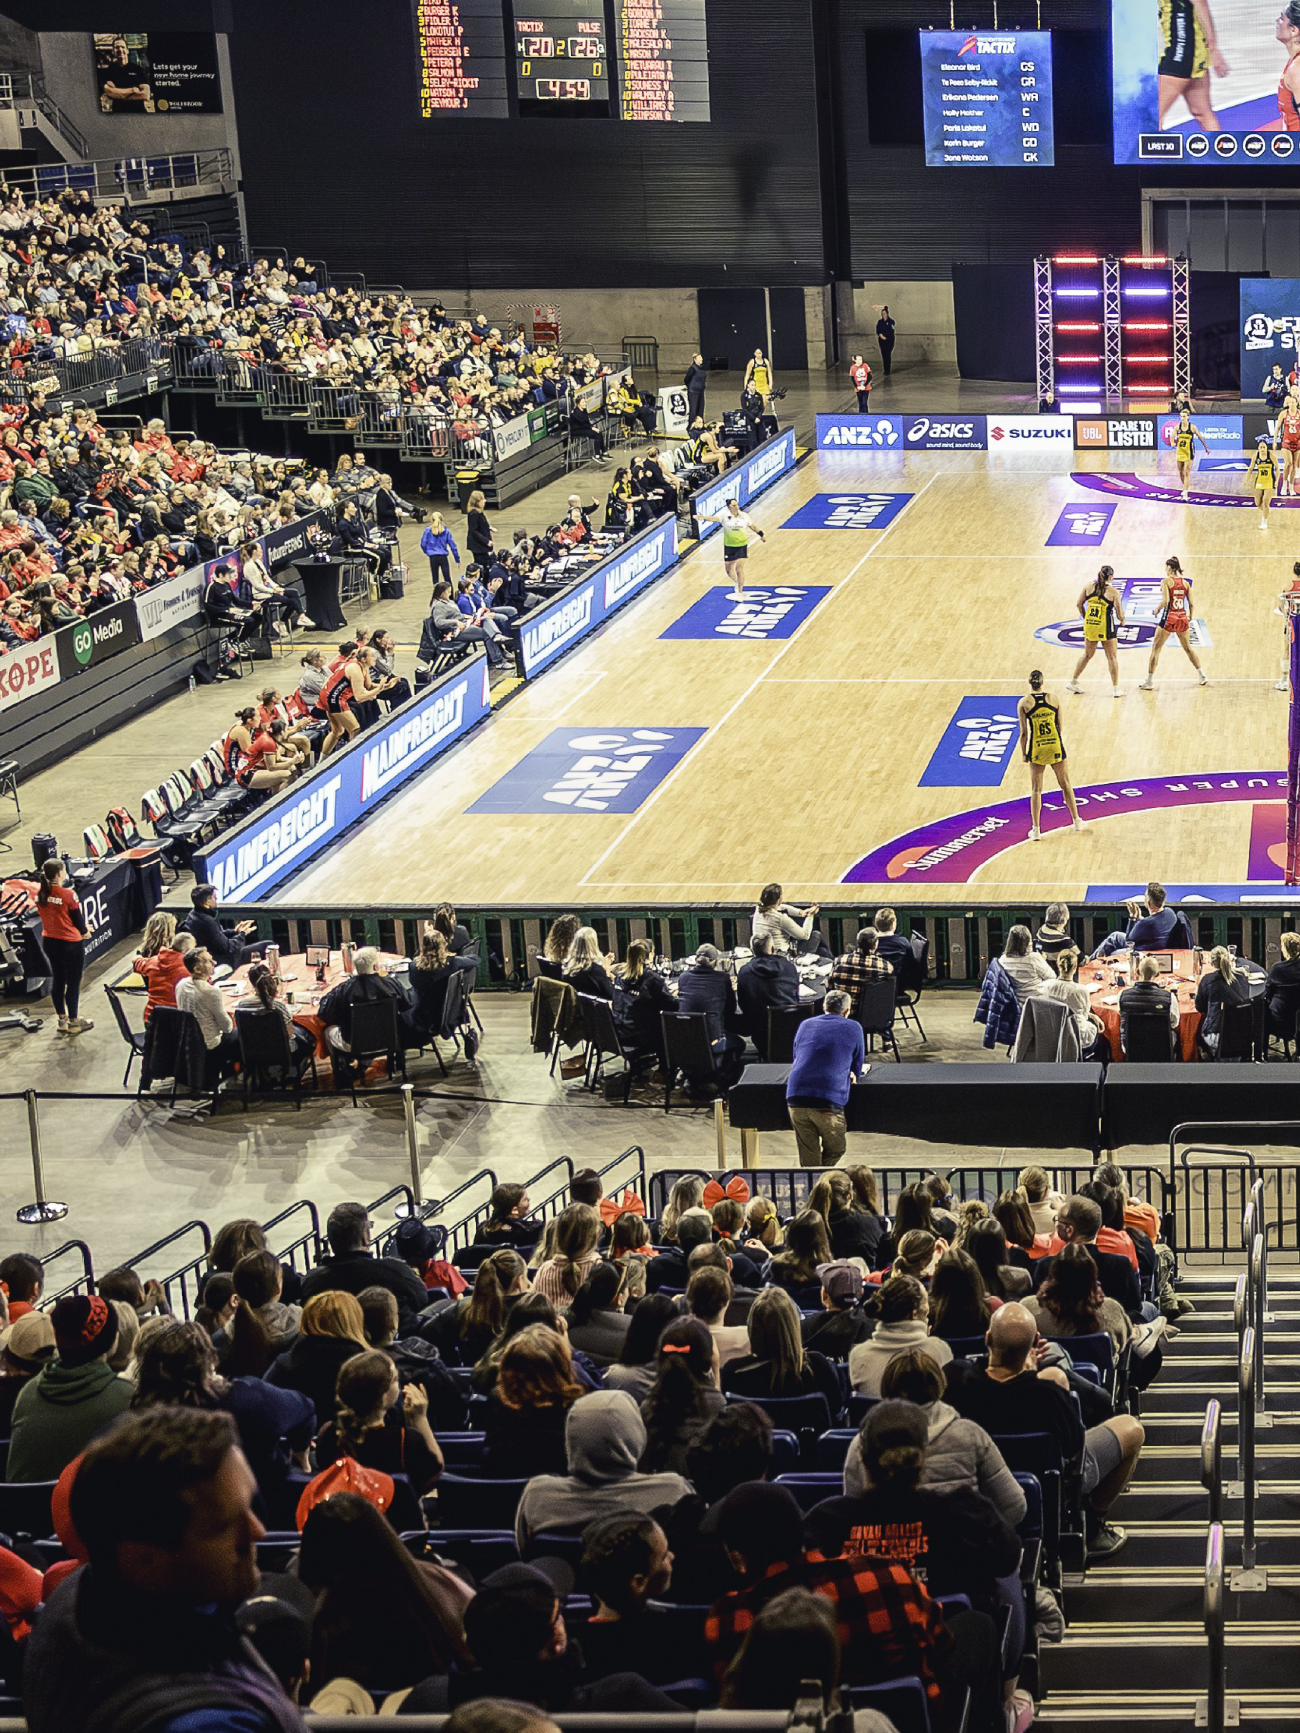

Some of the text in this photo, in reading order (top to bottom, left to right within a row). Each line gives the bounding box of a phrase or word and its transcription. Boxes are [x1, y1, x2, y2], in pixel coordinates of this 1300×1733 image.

[517, 21, 601, 32] TACTIX PULSE
[529, 38, 552, 56] 20
[556, 40, 566, 54] 2
[574, 39, 597, 56] 26
[977, 42, 1016, 54] TACTIX
[522, 62, 602, 76] 0 0
[1020, 62, 1034, 72] GS
[1021, 77, 1036, 86] GA
[1021, 93, 1039, 102] WA
[1022, 108, 1030, 116] C
[1022, 122, 1040, 132] WD
[1022, 138, 1038, 147] GD
[1023, 152, 1038, 162] GK
[1108, 420, 1154, 432] DARE TO
[822, 426, 872, 445] ANZ
[1009, 429, 1072, 438] SUZUKI
[1082, 427, 1102, 440] JBL
[1108, 432, 1154, 446] LISTEN
[604, 532, 666, 610] MAINFREIGHT
[74, 616, 124, 654] GO Media
[1040, 722, 1052, 736] GS
[361, 680, 468, 803] MAINFREIGHT
[902, 816, 1010, 871] Summerset
